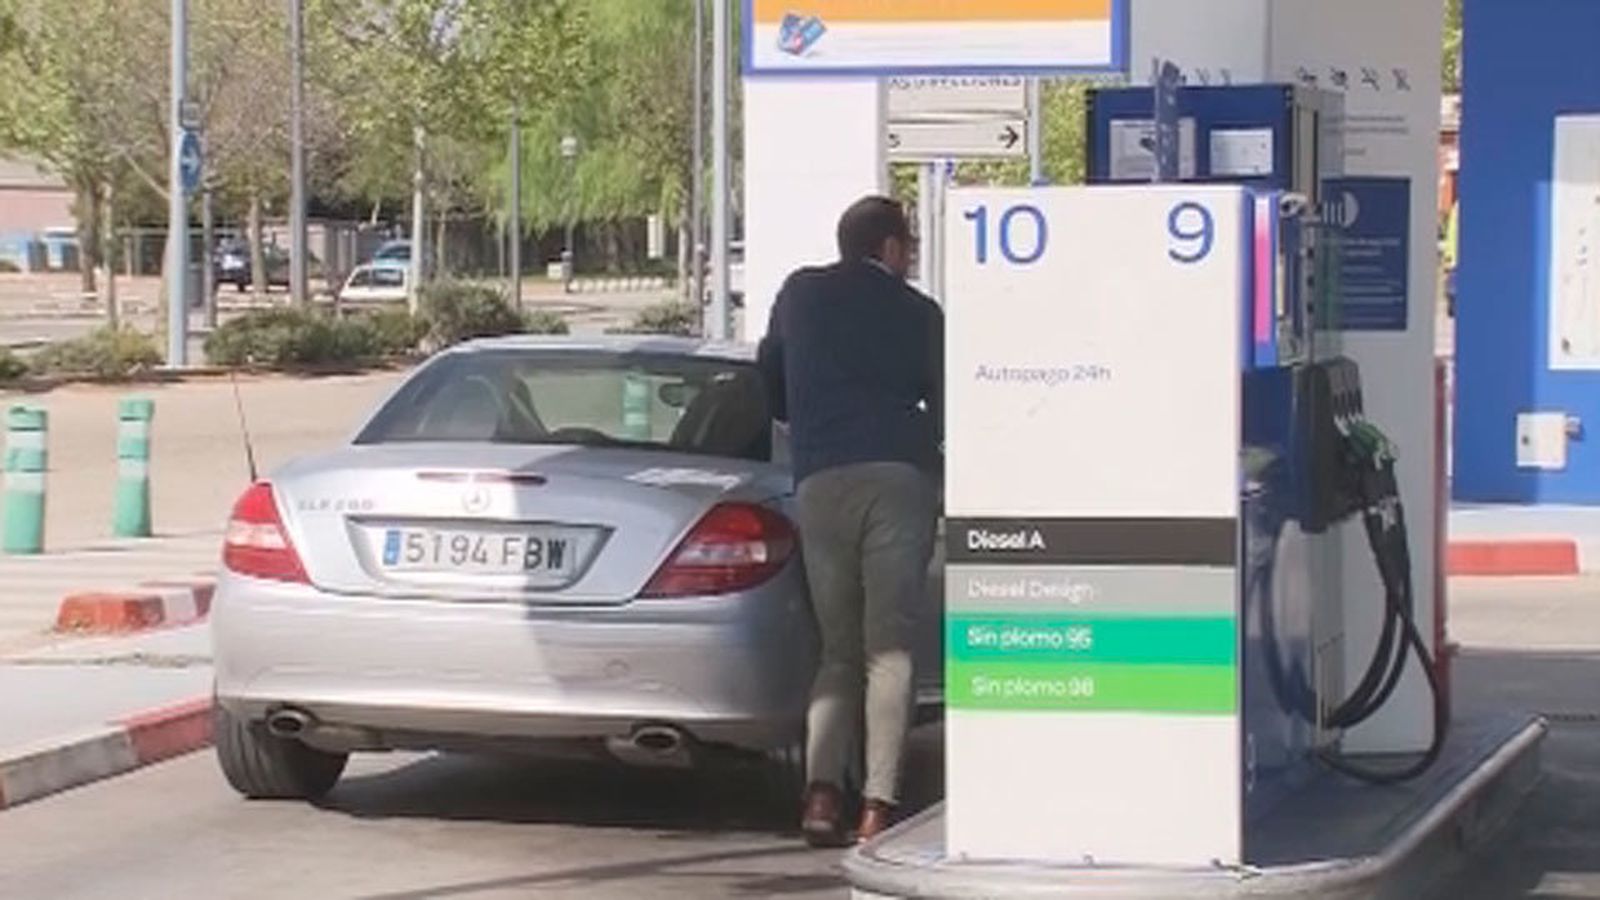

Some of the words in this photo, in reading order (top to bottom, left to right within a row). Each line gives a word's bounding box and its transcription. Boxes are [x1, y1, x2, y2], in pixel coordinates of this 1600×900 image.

[963, 204, 1048, 265] 10
[1167, 201, 1215, 264] 9
[405, 532, 488, 566] 5194
[501, 536, 567, 570] FBW
[967, 529, 1025, 550] Diesel
[1027, 530, 1046, 550] A
[967, 579, 1025, 599] Diesel
[966, 624, 998, 647] Sin
[1000, 625, 1063, 652] plomo
[971, 675, 1001, 697] Sin
[1002, 675, 1066, 702] plomo
